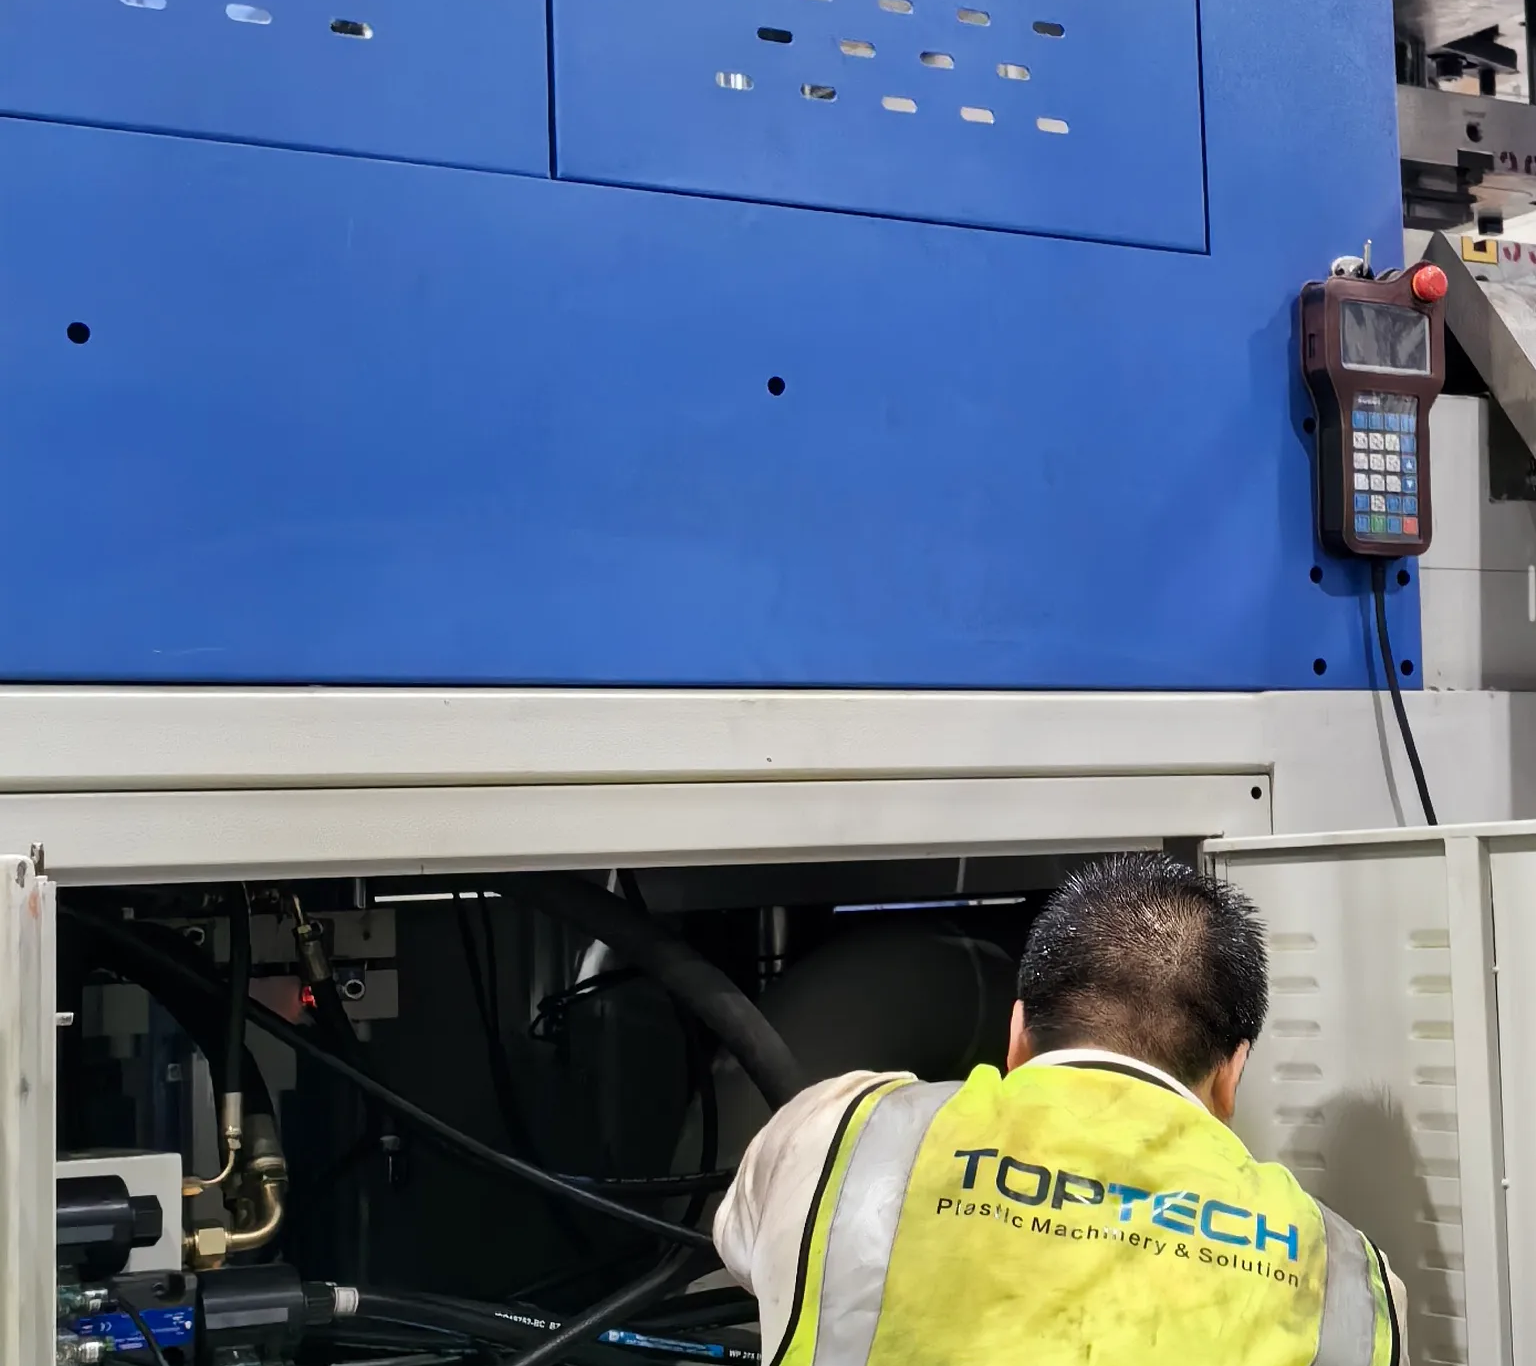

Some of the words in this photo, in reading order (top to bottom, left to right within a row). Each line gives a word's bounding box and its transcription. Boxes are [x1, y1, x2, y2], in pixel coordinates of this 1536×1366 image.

[936, 1196, 1024, 1230] Plastic
[1030, 1216, 1168, 1257] Machinery
[1174, 1242, 1191, 1260] &
[1198, 1246, 1301, 1288] Solution
[954, 1147, 1299, 1262] TOPTECH
